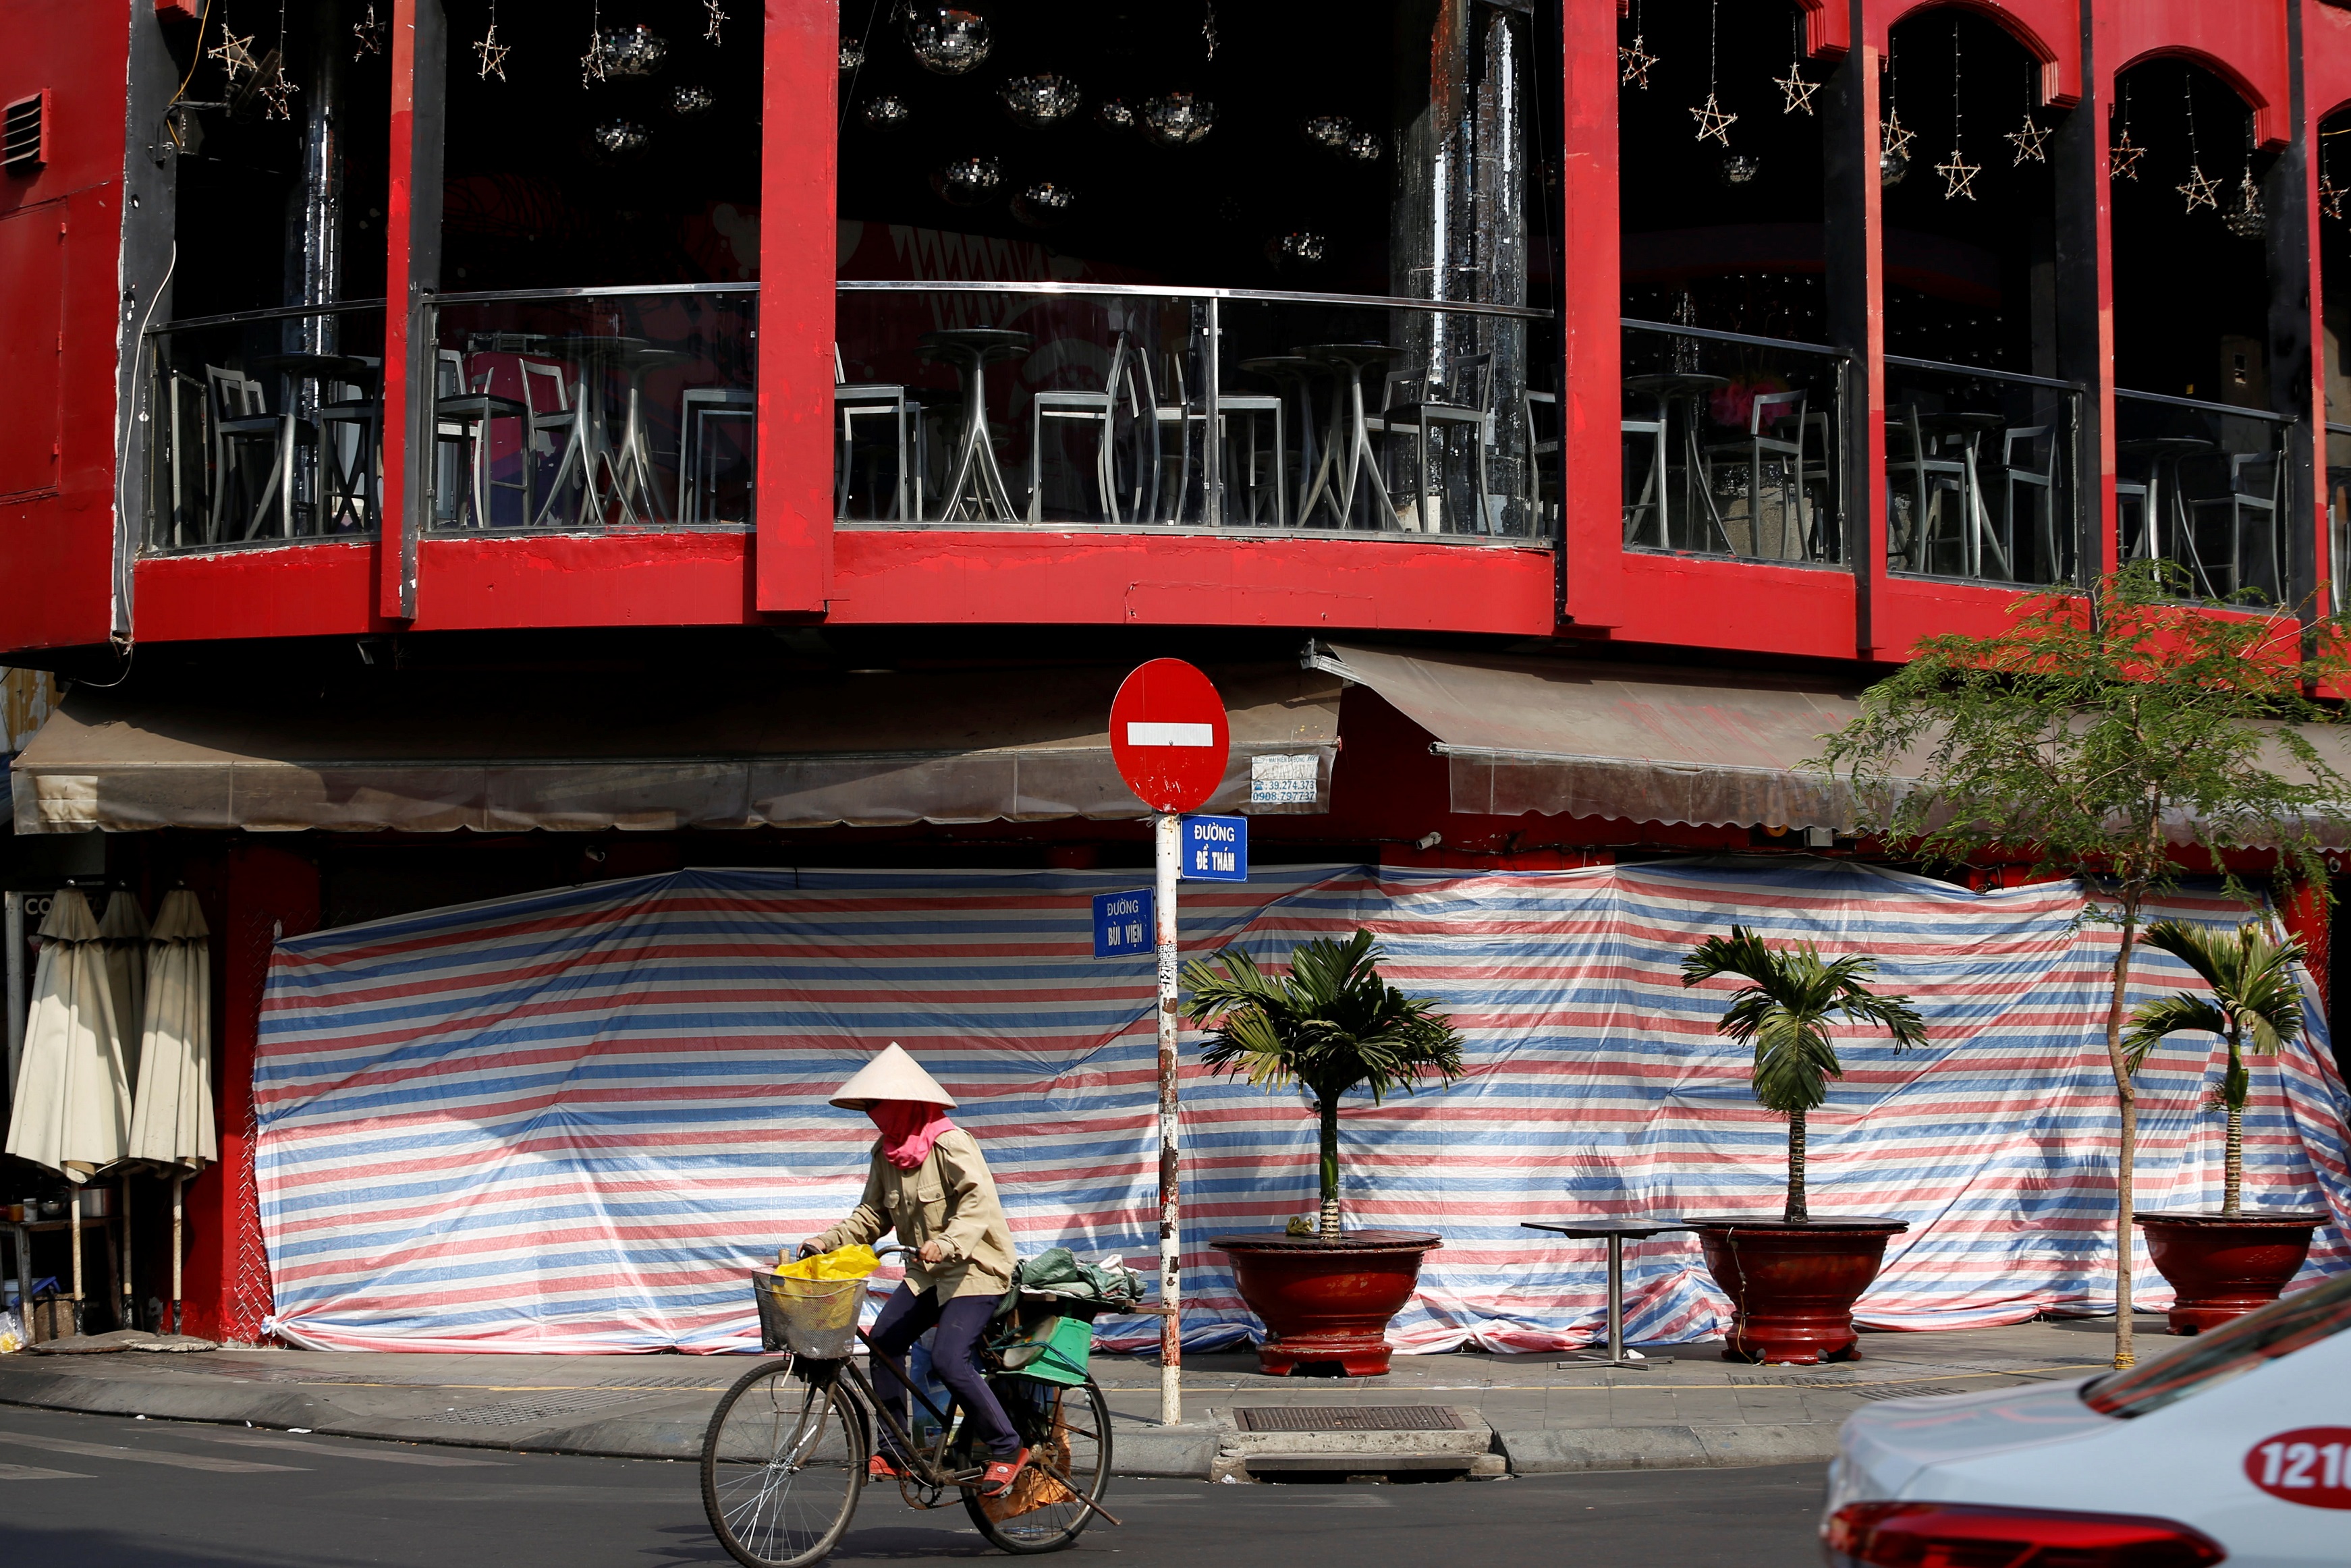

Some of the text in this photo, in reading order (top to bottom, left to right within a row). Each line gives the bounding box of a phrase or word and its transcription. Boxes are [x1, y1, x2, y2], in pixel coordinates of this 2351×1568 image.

[1252, 791, 1315, 802] 0908.797737
[1194, 822, 1235, 842] ĐƯỜNG
[1196, 843, 1235, 872] ĐỀ THÁM
[1107, 897, 1139, 917] ĐƯỜNG
[1107, 920, 1142, 948] BÙI VIỆN
